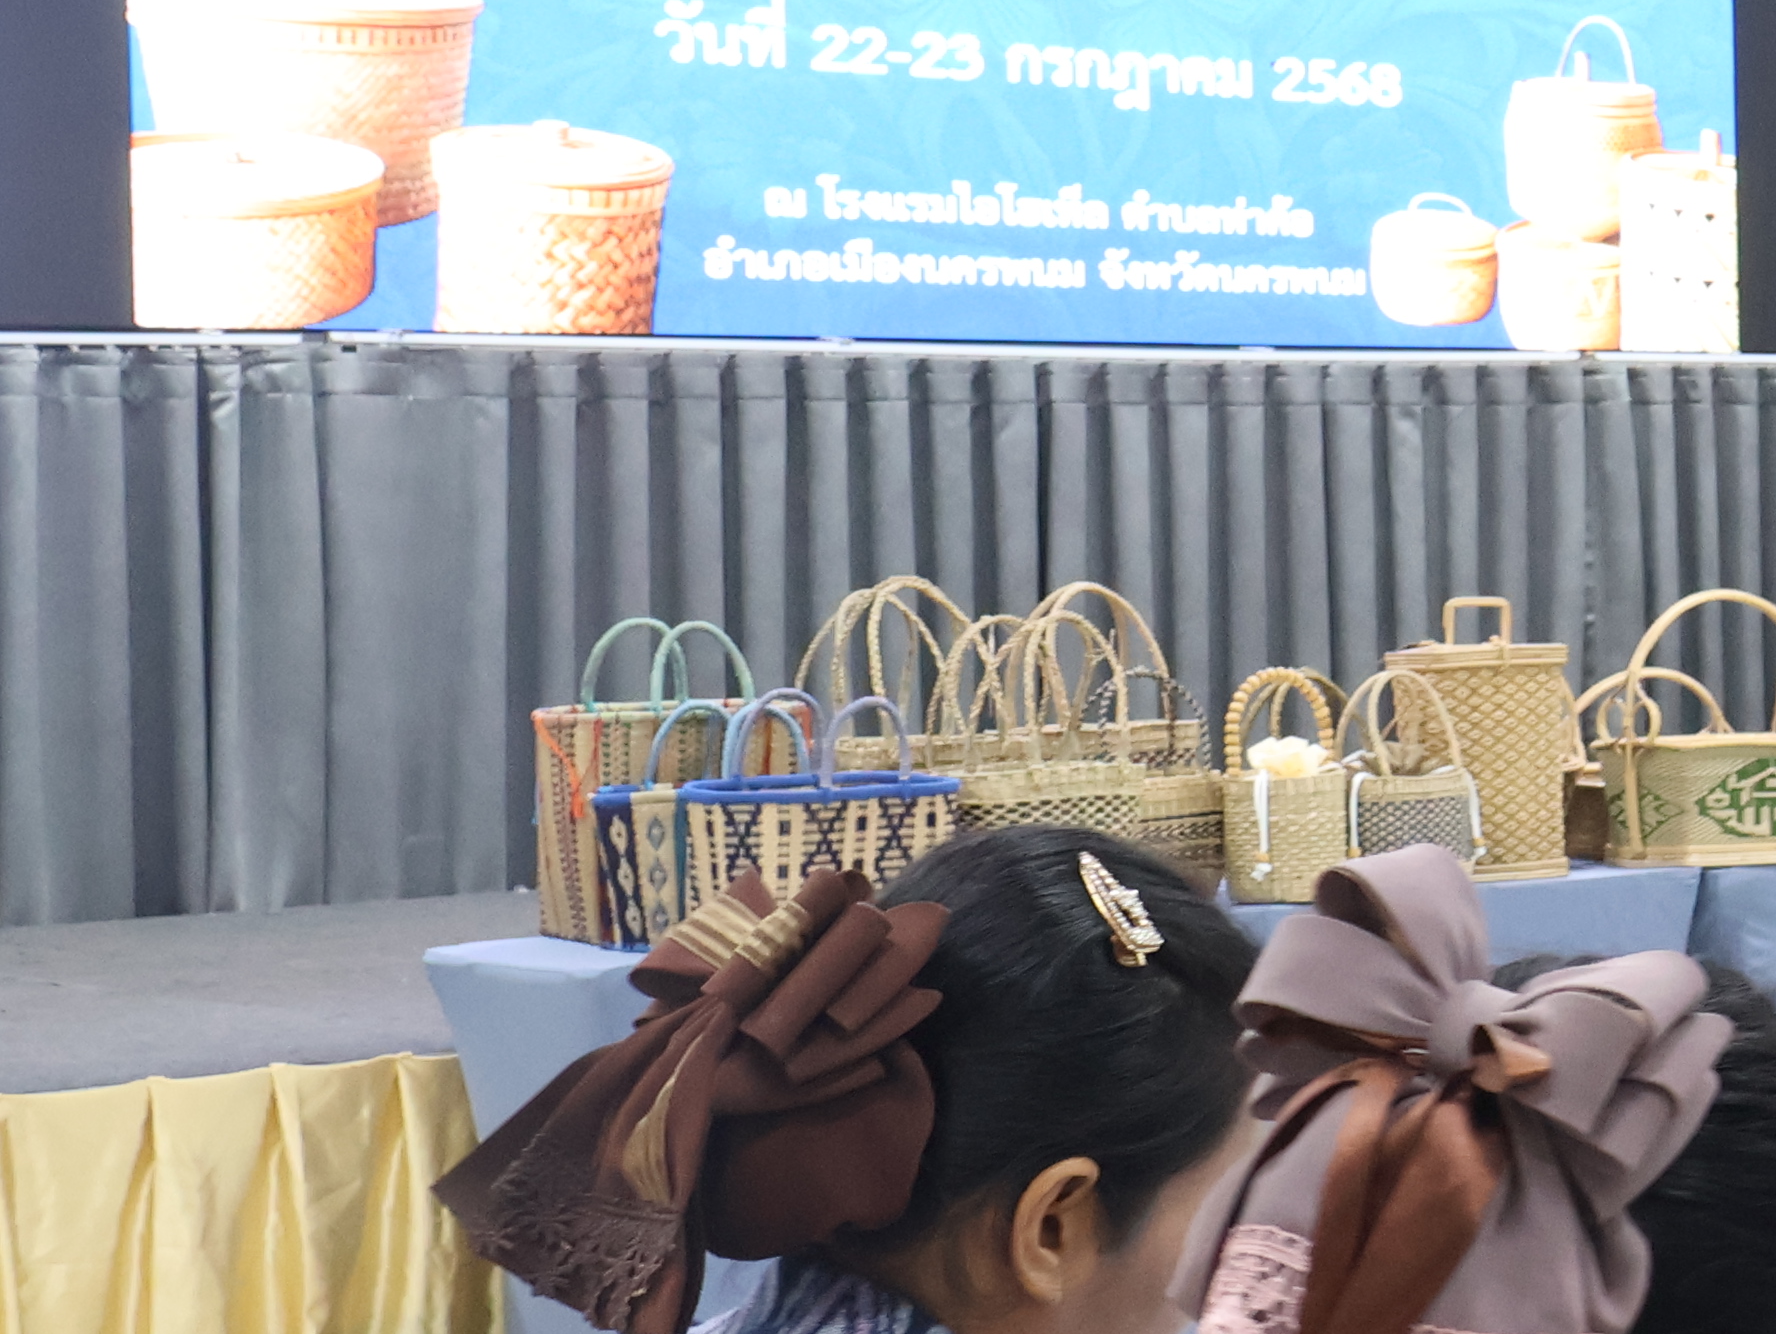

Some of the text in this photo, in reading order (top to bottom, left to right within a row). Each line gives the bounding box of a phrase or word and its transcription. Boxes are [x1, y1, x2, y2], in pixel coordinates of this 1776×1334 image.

[811, 25, 984, 80] 22-23
[1005, 43, 1252, 110] กรกฎาคม
[1272, 57, 1402, 107] 2568
[765, 187, 806, 218] ณ
